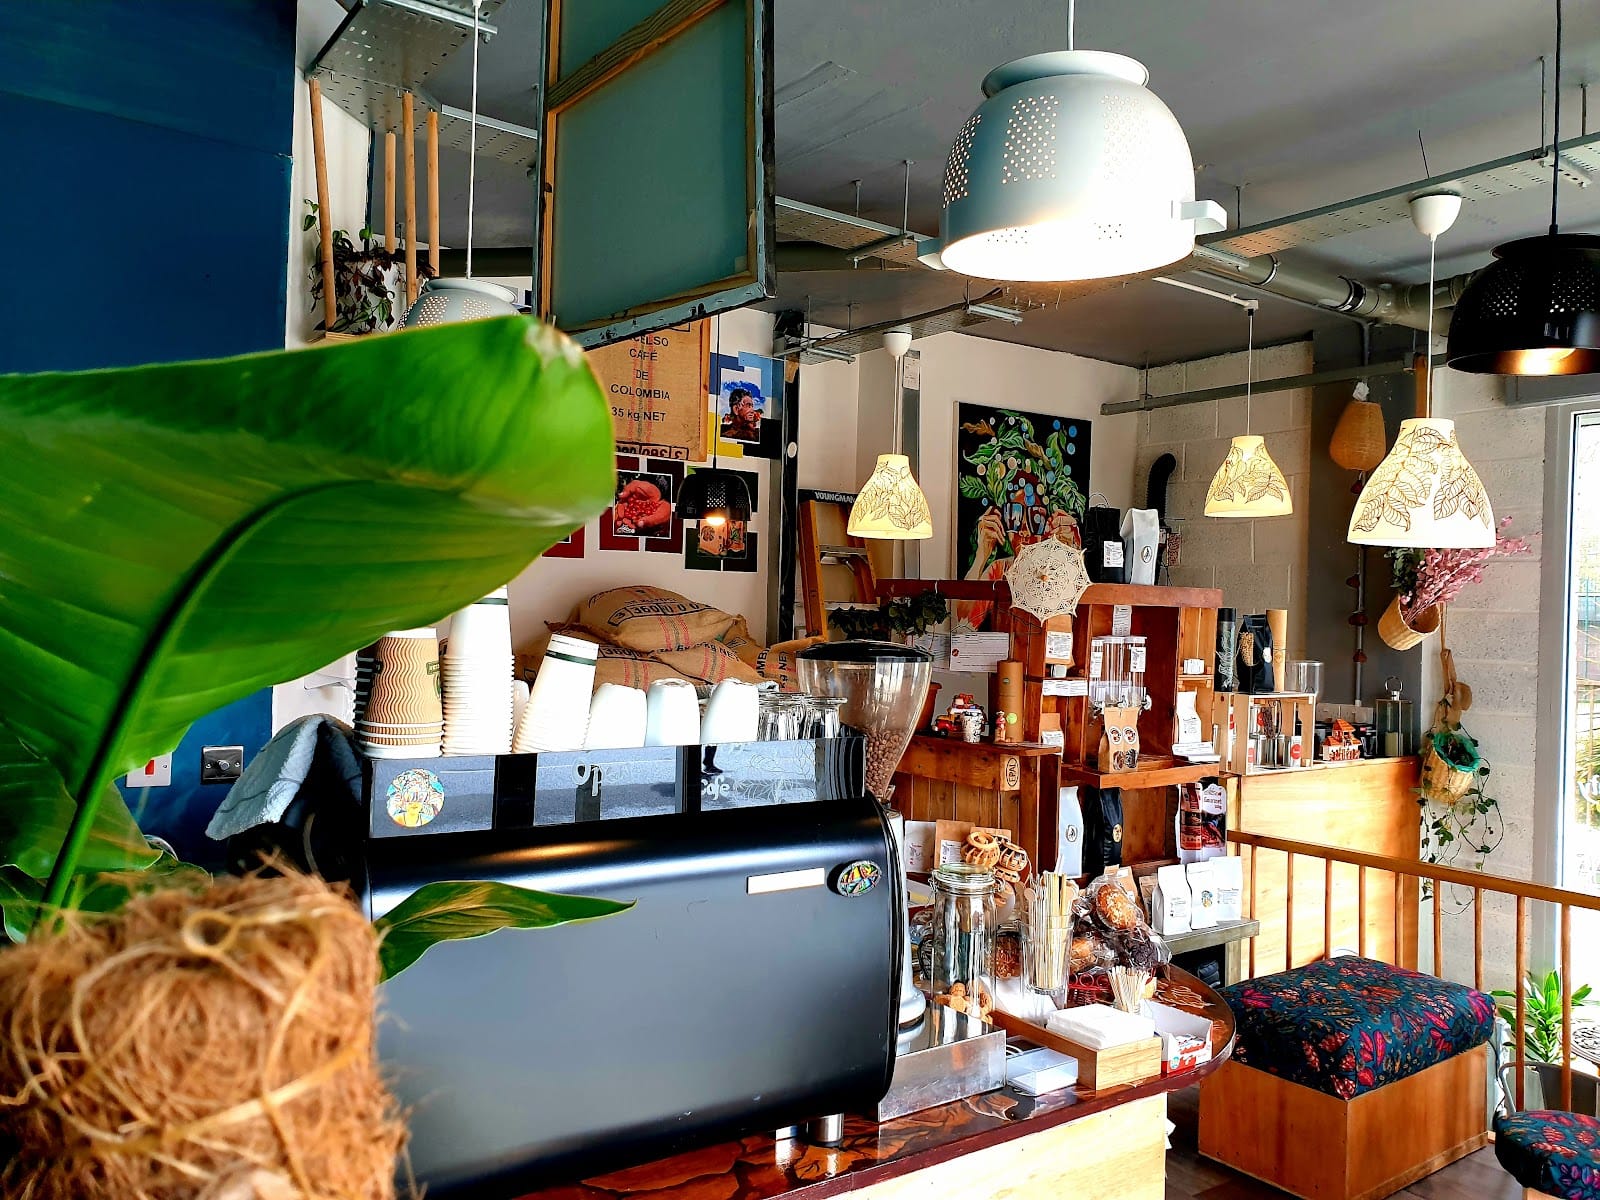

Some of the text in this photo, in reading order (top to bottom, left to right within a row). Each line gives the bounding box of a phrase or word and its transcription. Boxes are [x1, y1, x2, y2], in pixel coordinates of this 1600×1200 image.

[629, 348, 658, 361] CAFÉ
[635, 369, 649, 380] DE
[610, 383, 671, 401] COLOMBIA
[611, 406, 667, 422] 35 kg NET
[632, 605, 660, 614] 360
